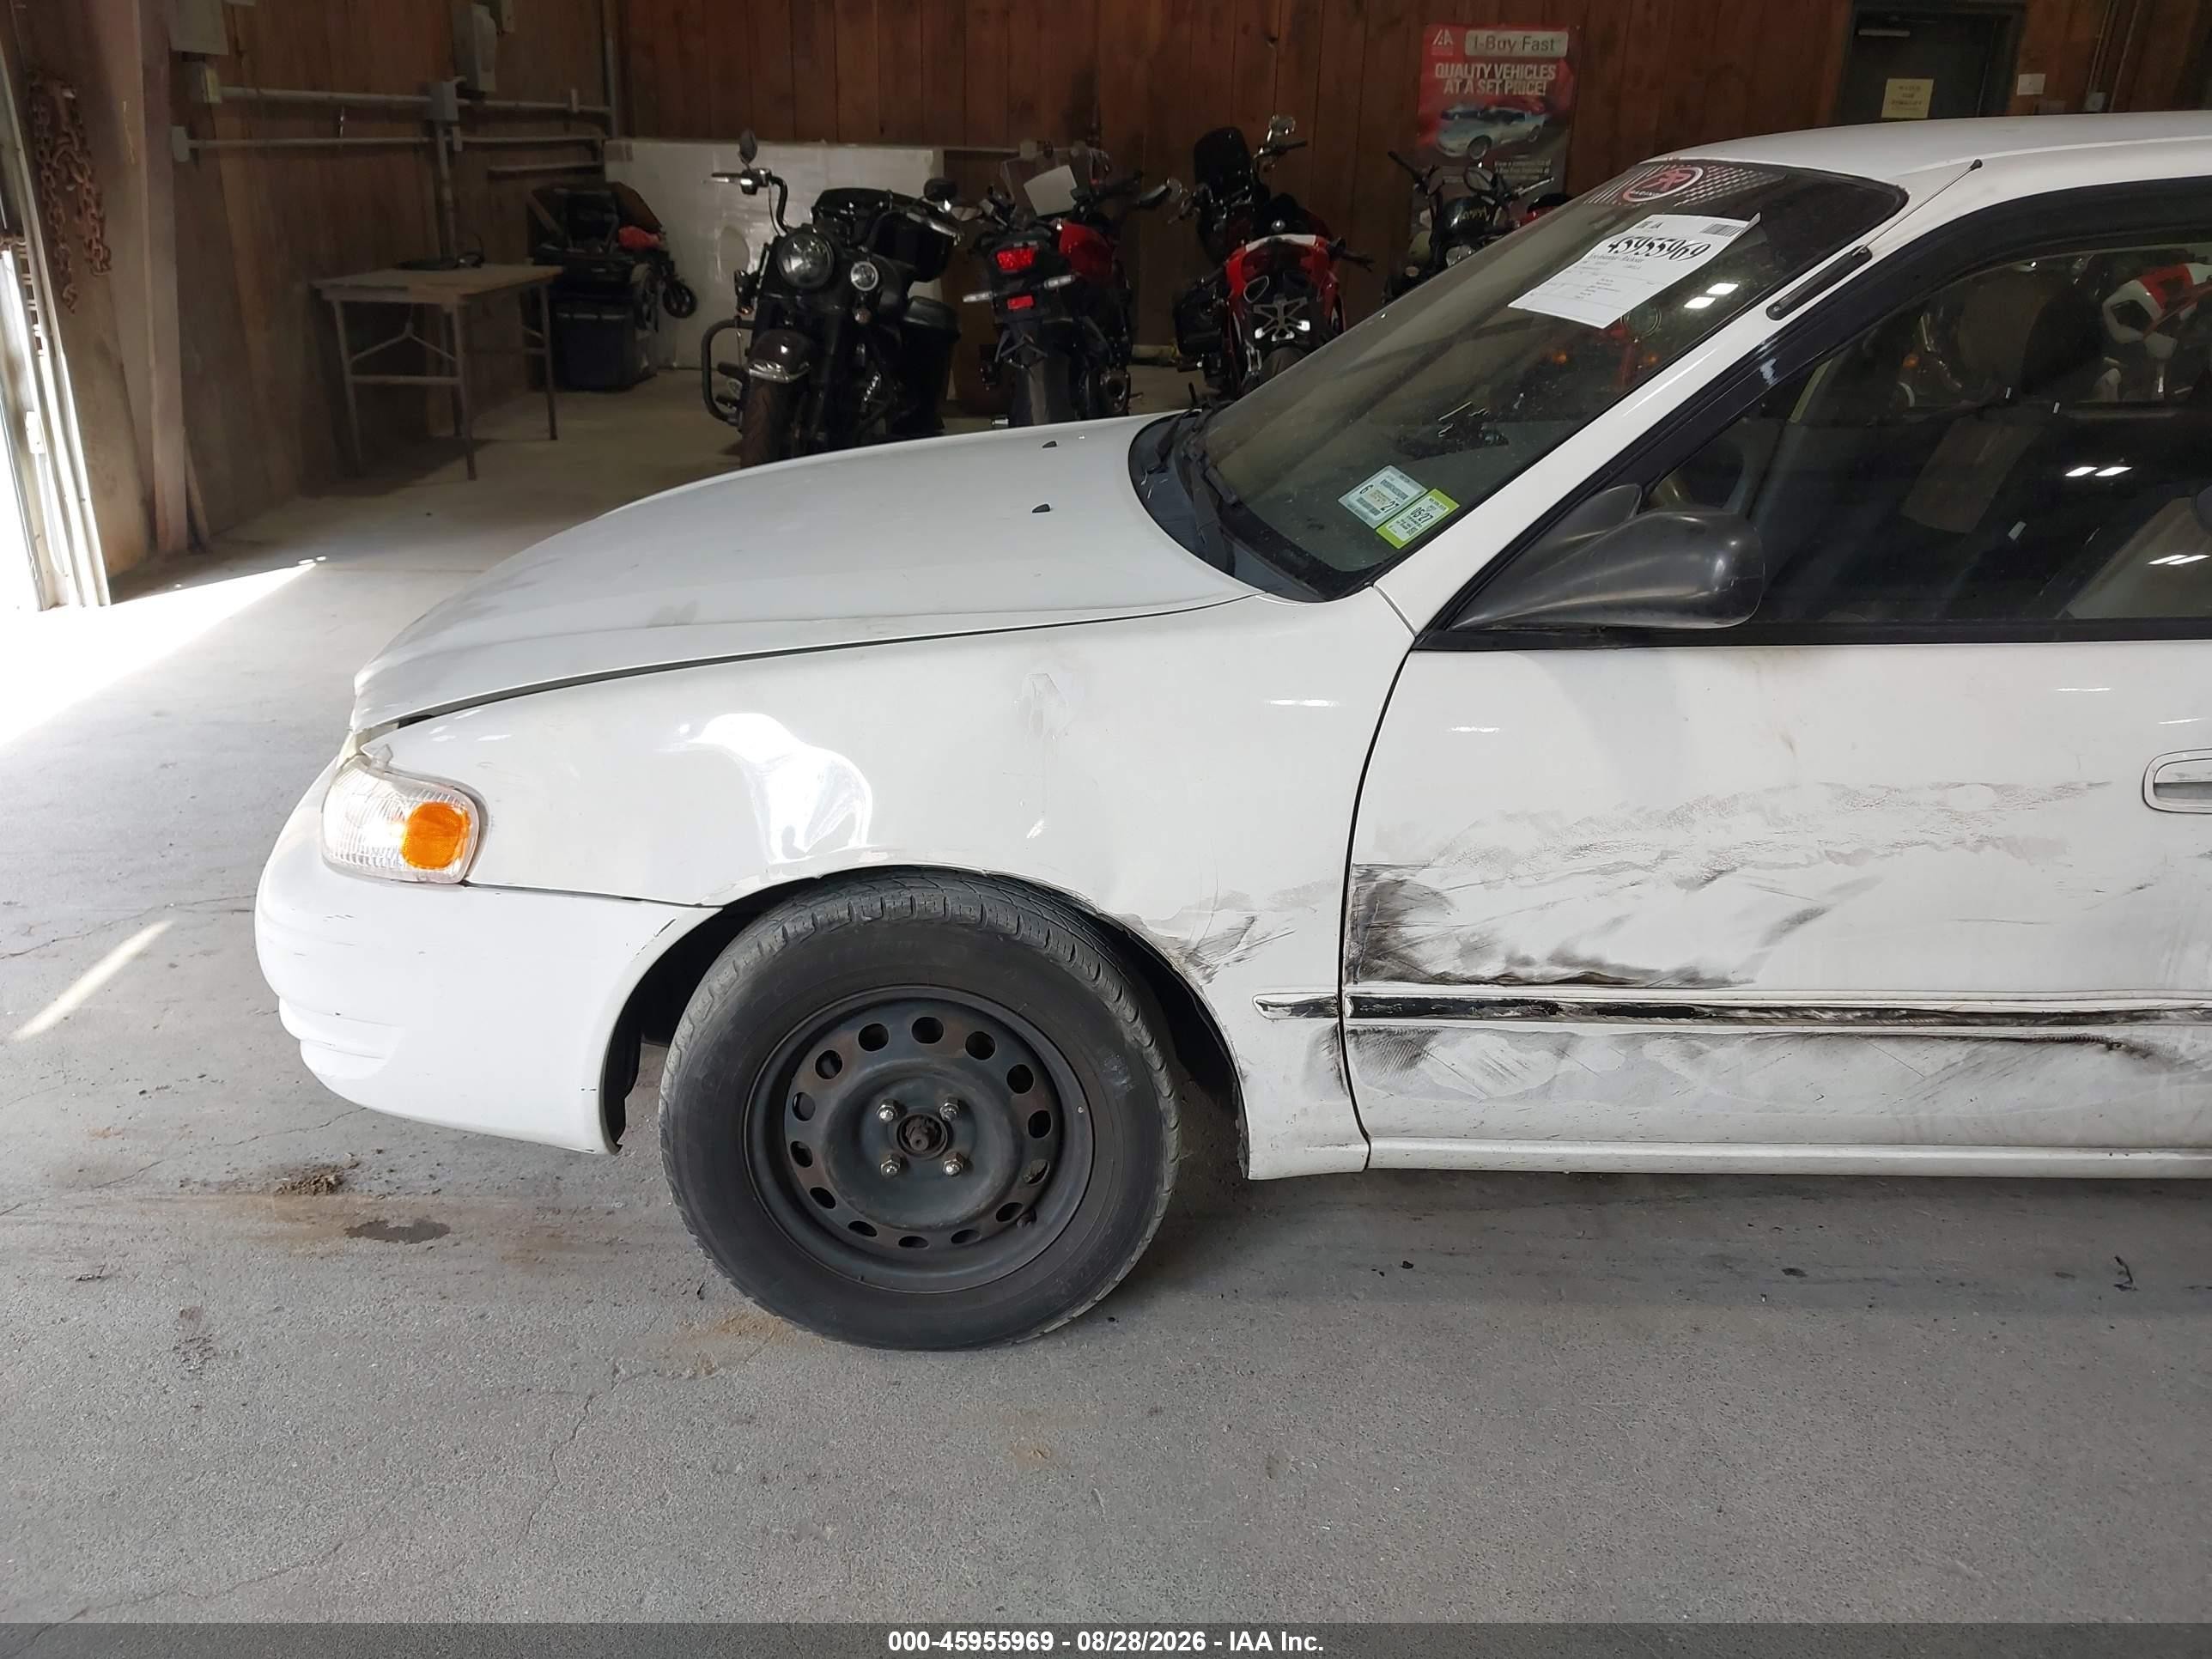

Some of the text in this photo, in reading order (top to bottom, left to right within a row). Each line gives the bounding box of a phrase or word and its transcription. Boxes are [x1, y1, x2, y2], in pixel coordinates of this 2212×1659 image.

[1474, 35, 1555, 52] I-Buy Fast
[1435, 63, 1556, 80] QUALITY VEHICLES
[1443, 78, 1548, 96] AT A SET PRICE!
[1607, 235, 1711, 261] 45955969
[1380, 501, 1400, 514] 27
